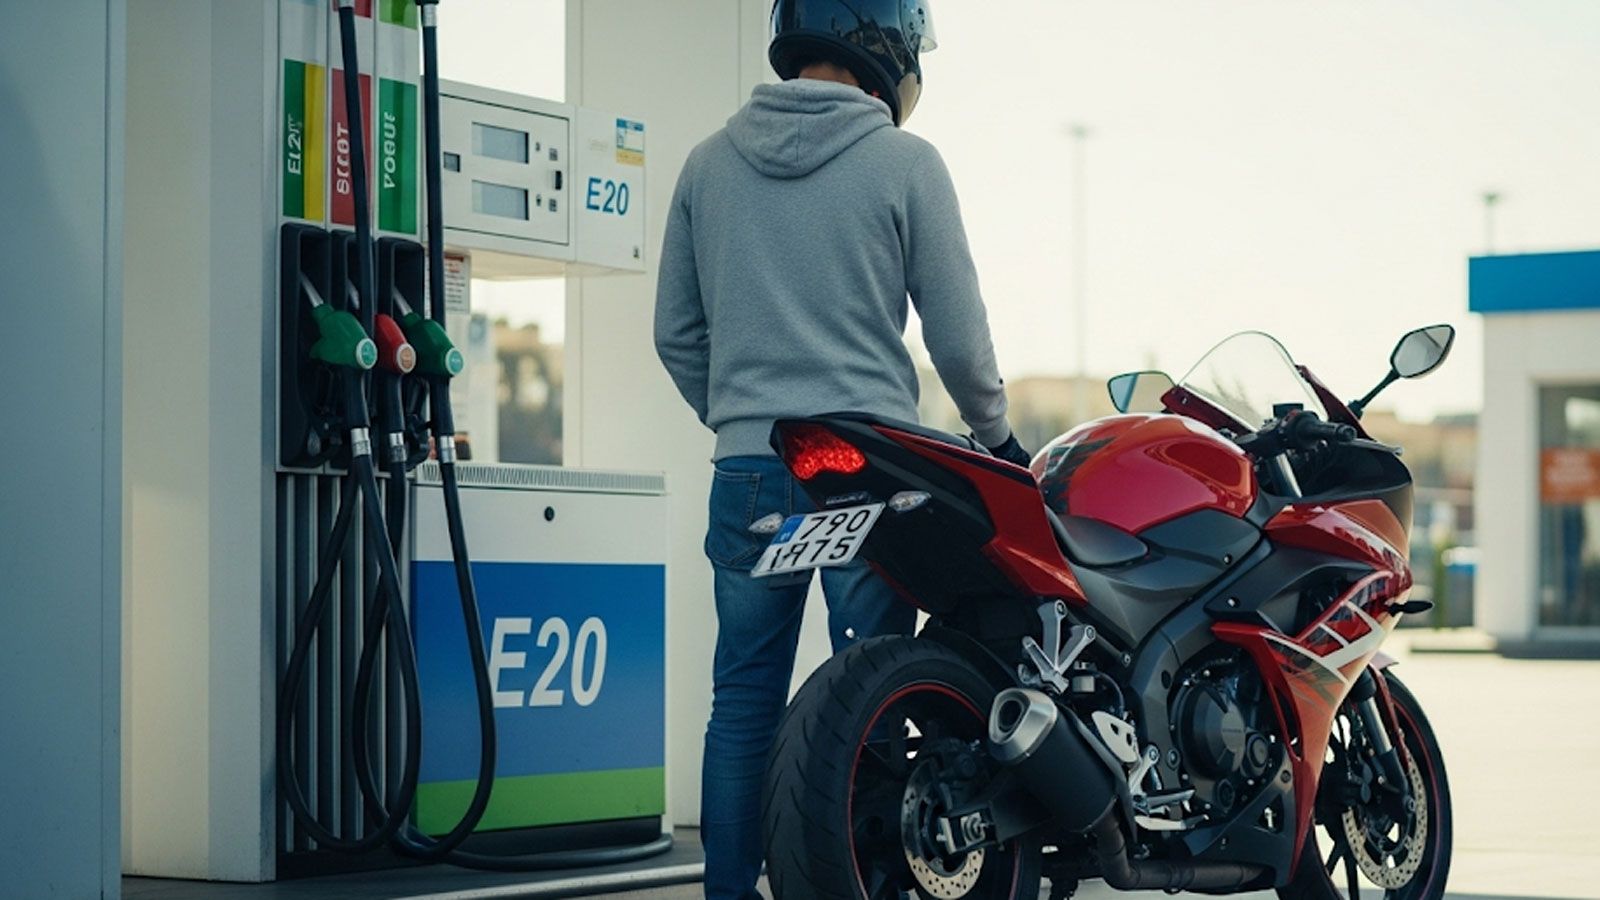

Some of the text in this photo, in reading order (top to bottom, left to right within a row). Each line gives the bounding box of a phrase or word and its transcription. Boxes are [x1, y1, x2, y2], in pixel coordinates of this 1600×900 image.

[586, 176, 630, 216] E20
[800, 510, 871, 541] 790
[489, 616, 608, 709] E20
